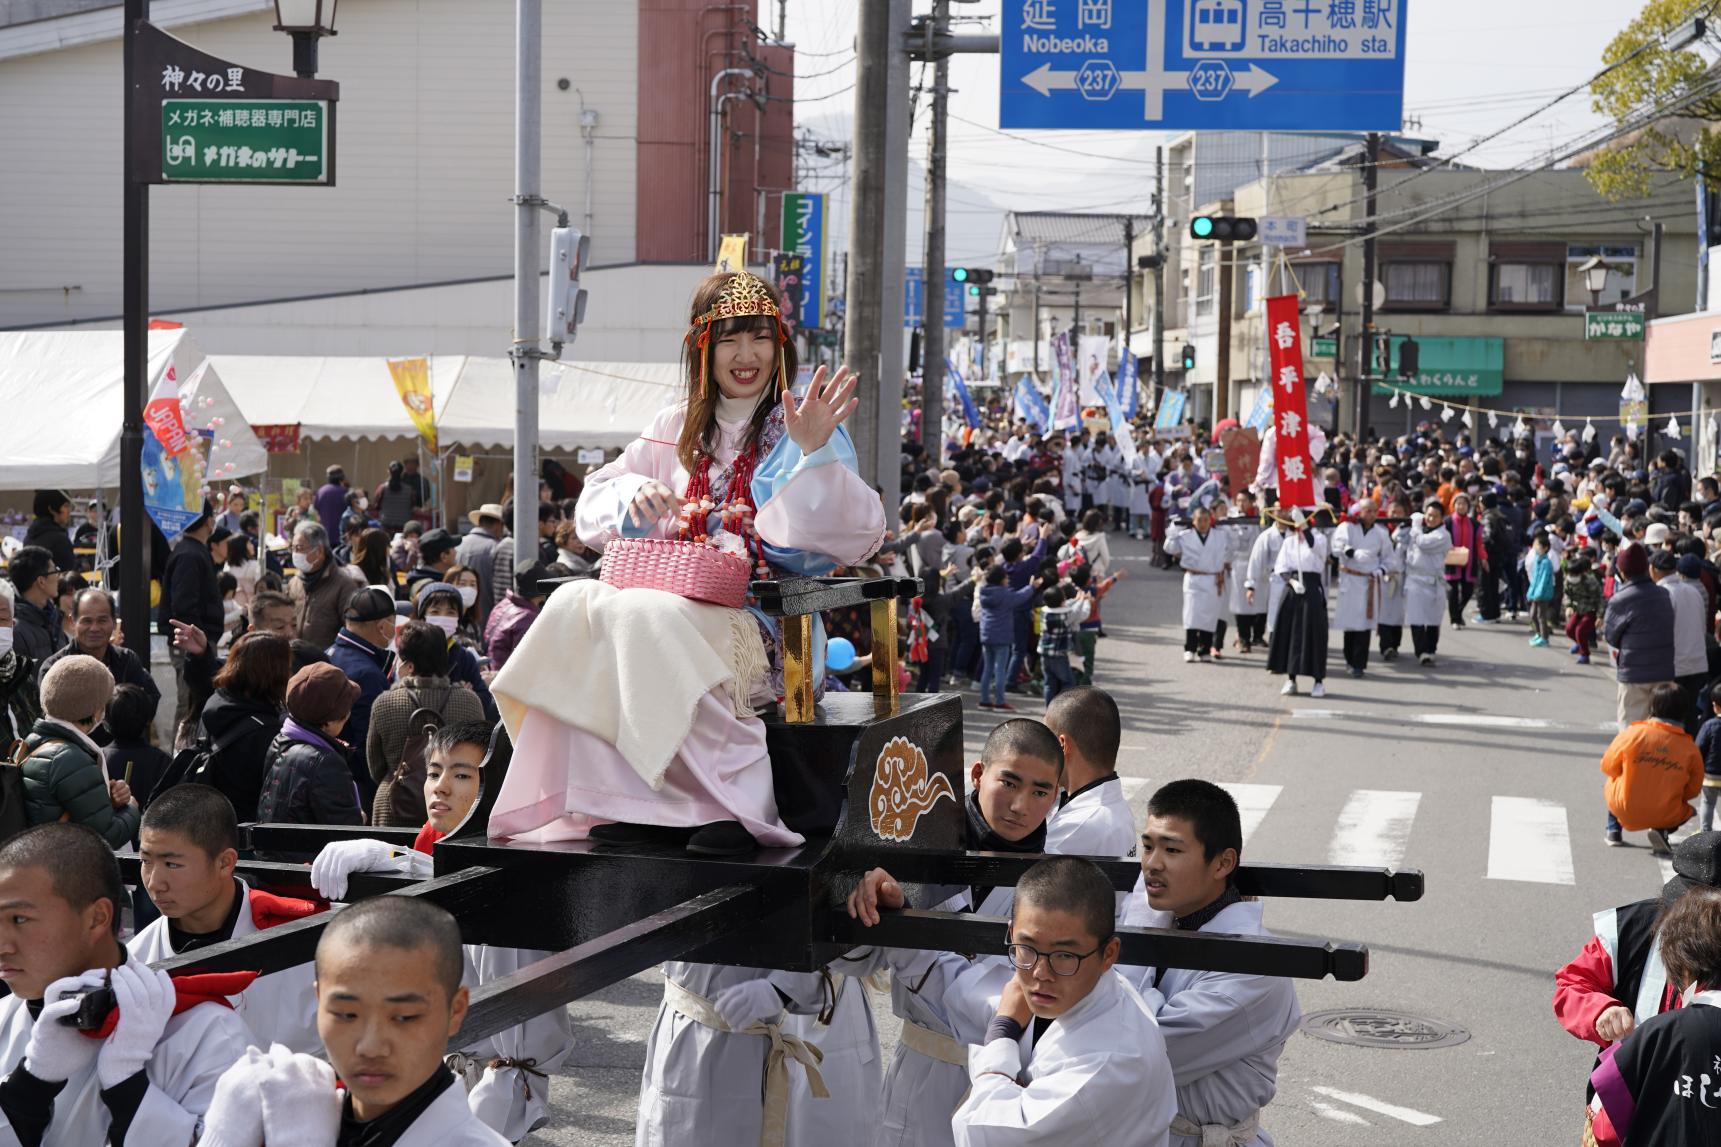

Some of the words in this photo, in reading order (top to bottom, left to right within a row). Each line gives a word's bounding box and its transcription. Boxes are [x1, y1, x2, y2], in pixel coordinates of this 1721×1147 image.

[1023, 34, 1109, 53] Nobeoka
[1258, 34, 1349, 53] Takachiho
[1361, 35, 1392, 53] sta.
[161, 64, 245, 92] 神々の里
[1083, 70, 1113, 90] 237
[1196, 70, 1226, 90] 237
[167, 109, 317, 128] メガネ・補聴器専門店
[203, 145, 319, 169] メガネのサトー
[1588, 322, 1642, 337] かなや
[1273, 320, 1307, 483] 吾平津姫
[150, 405, 188, 453] JAPAN
